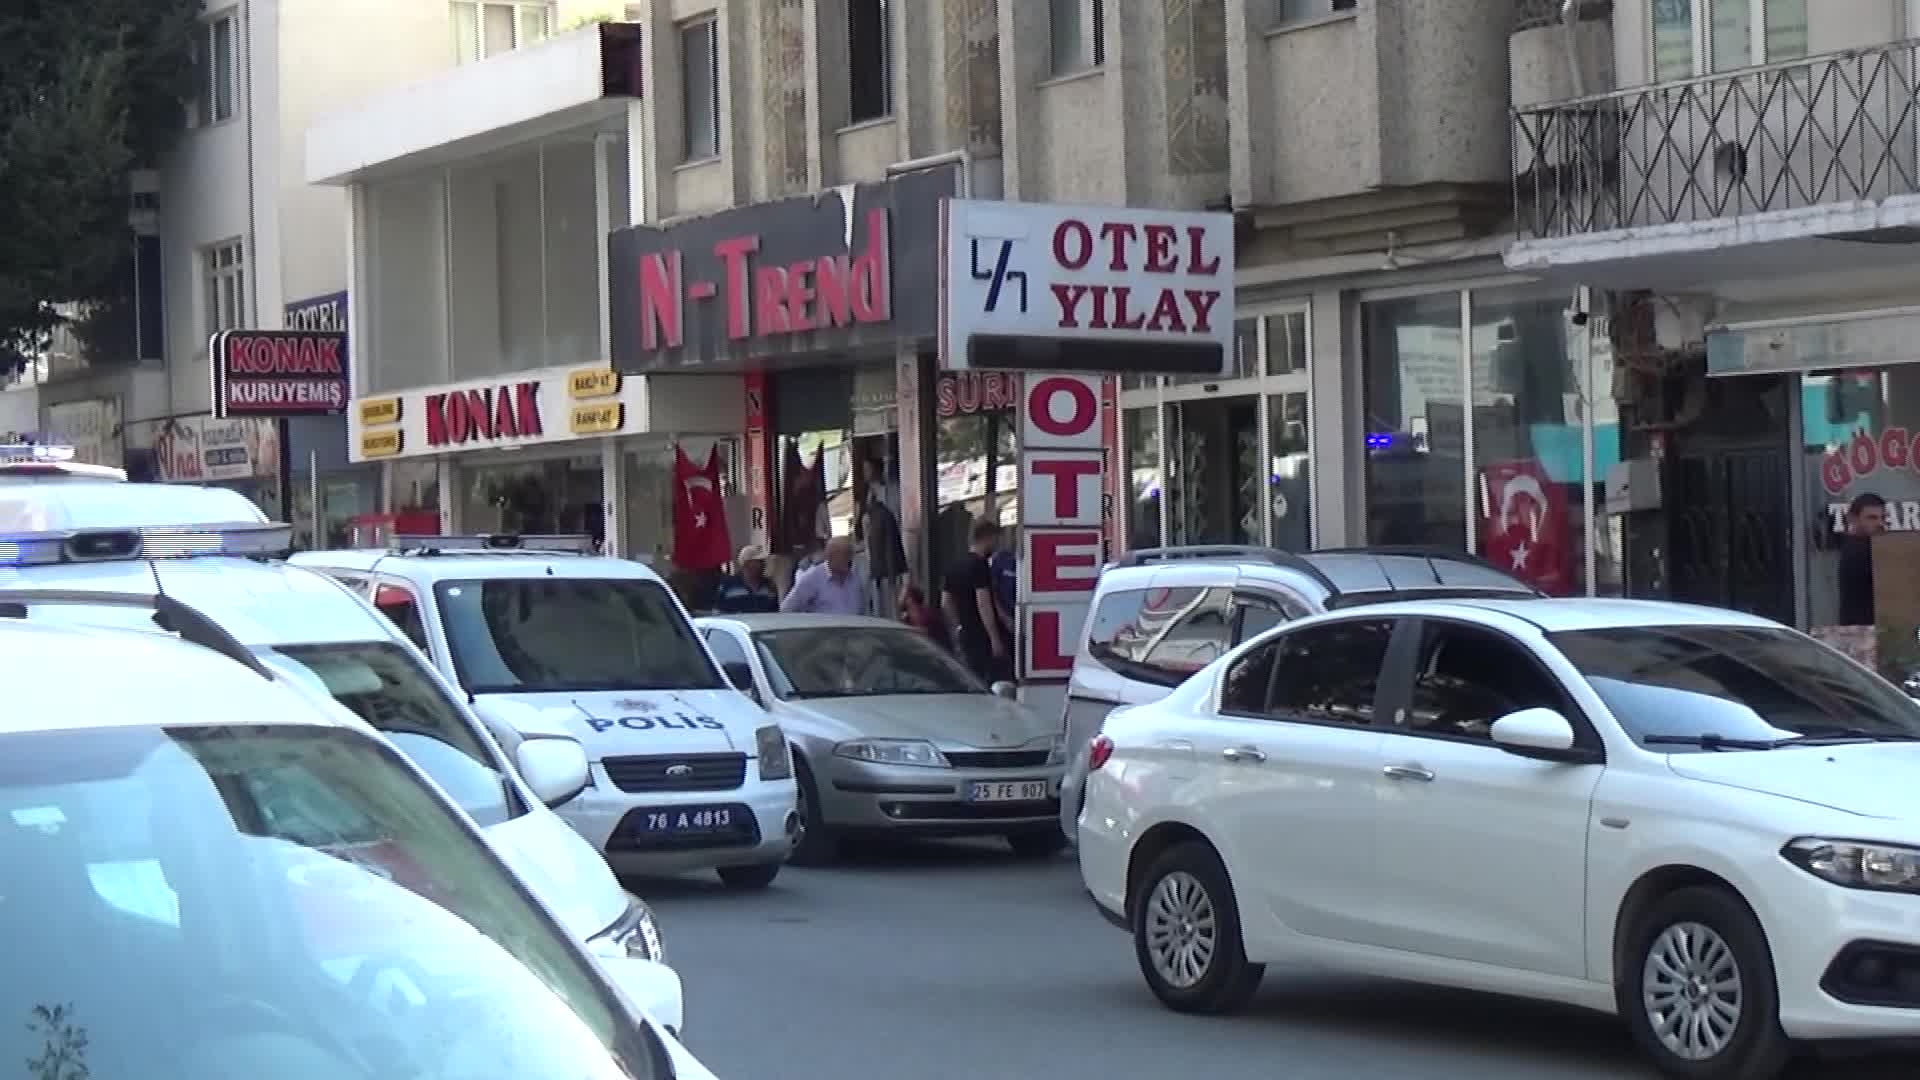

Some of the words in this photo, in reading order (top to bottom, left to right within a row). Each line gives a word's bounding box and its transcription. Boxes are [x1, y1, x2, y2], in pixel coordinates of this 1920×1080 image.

[1052, 219, 1220, 275] OTEL
[1050, 284, 1221, 333] YILAY
[230, 337, 341, 373] KONAK
[230, 381, 341, 406] KURUYEMİŞ
[424, 382, 544, 447] KONAK
[1029, 376, 1101, 671] OTEL
[585, 712, 725, 733] POLİS
[677, 812, 689, 828] A
